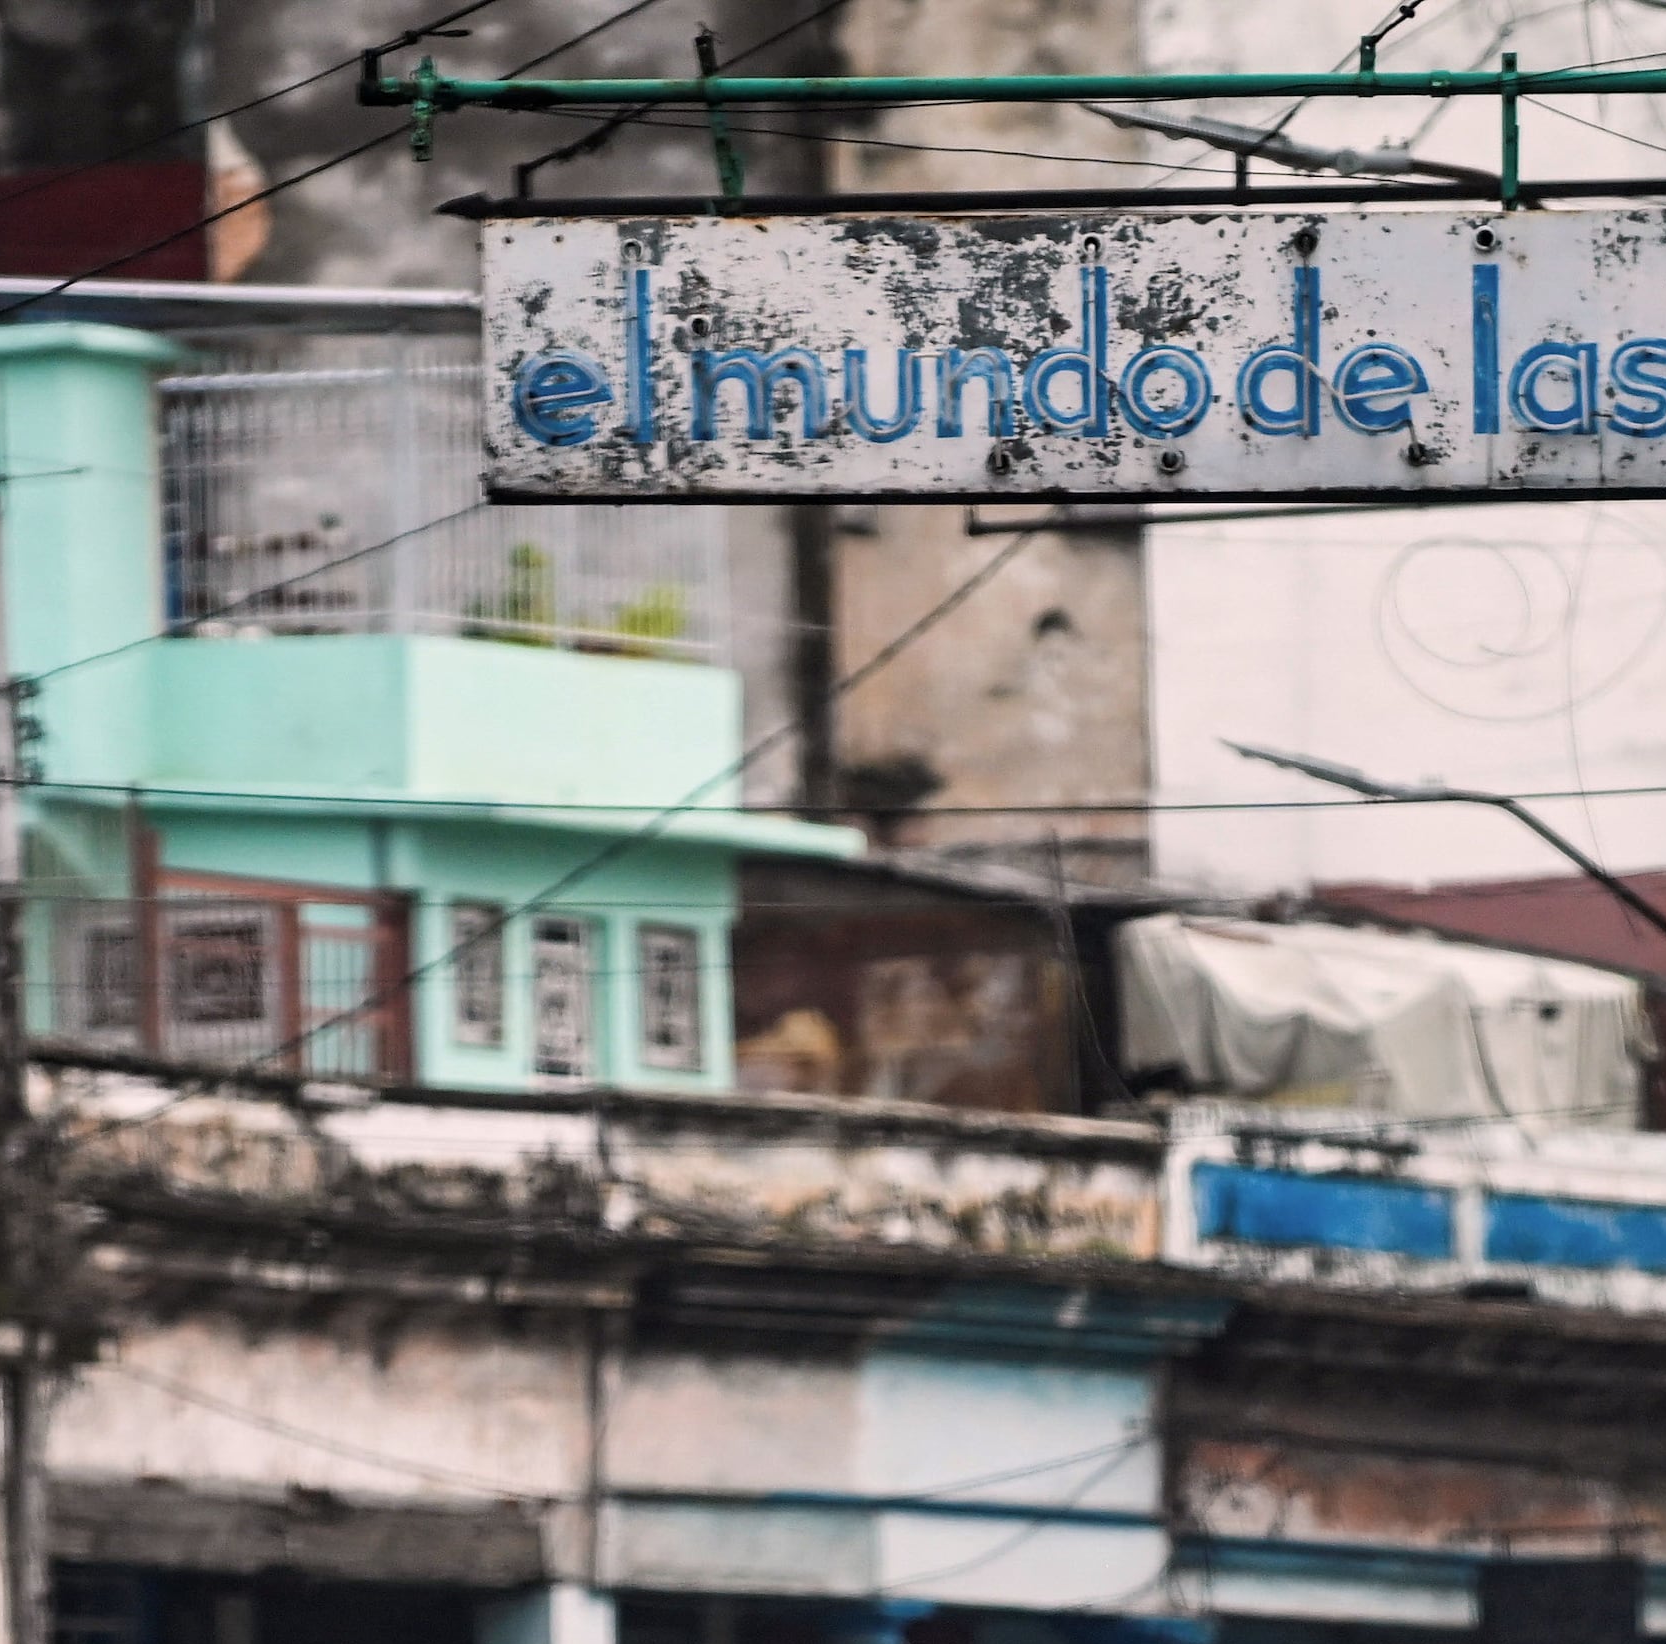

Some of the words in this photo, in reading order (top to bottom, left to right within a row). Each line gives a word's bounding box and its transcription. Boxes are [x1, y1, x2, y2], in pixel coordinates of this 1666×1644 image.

[512, 268, 656, 447] el
[690, 266, 1215, 443] mundo
[1236, 265, 1431, 437] de
